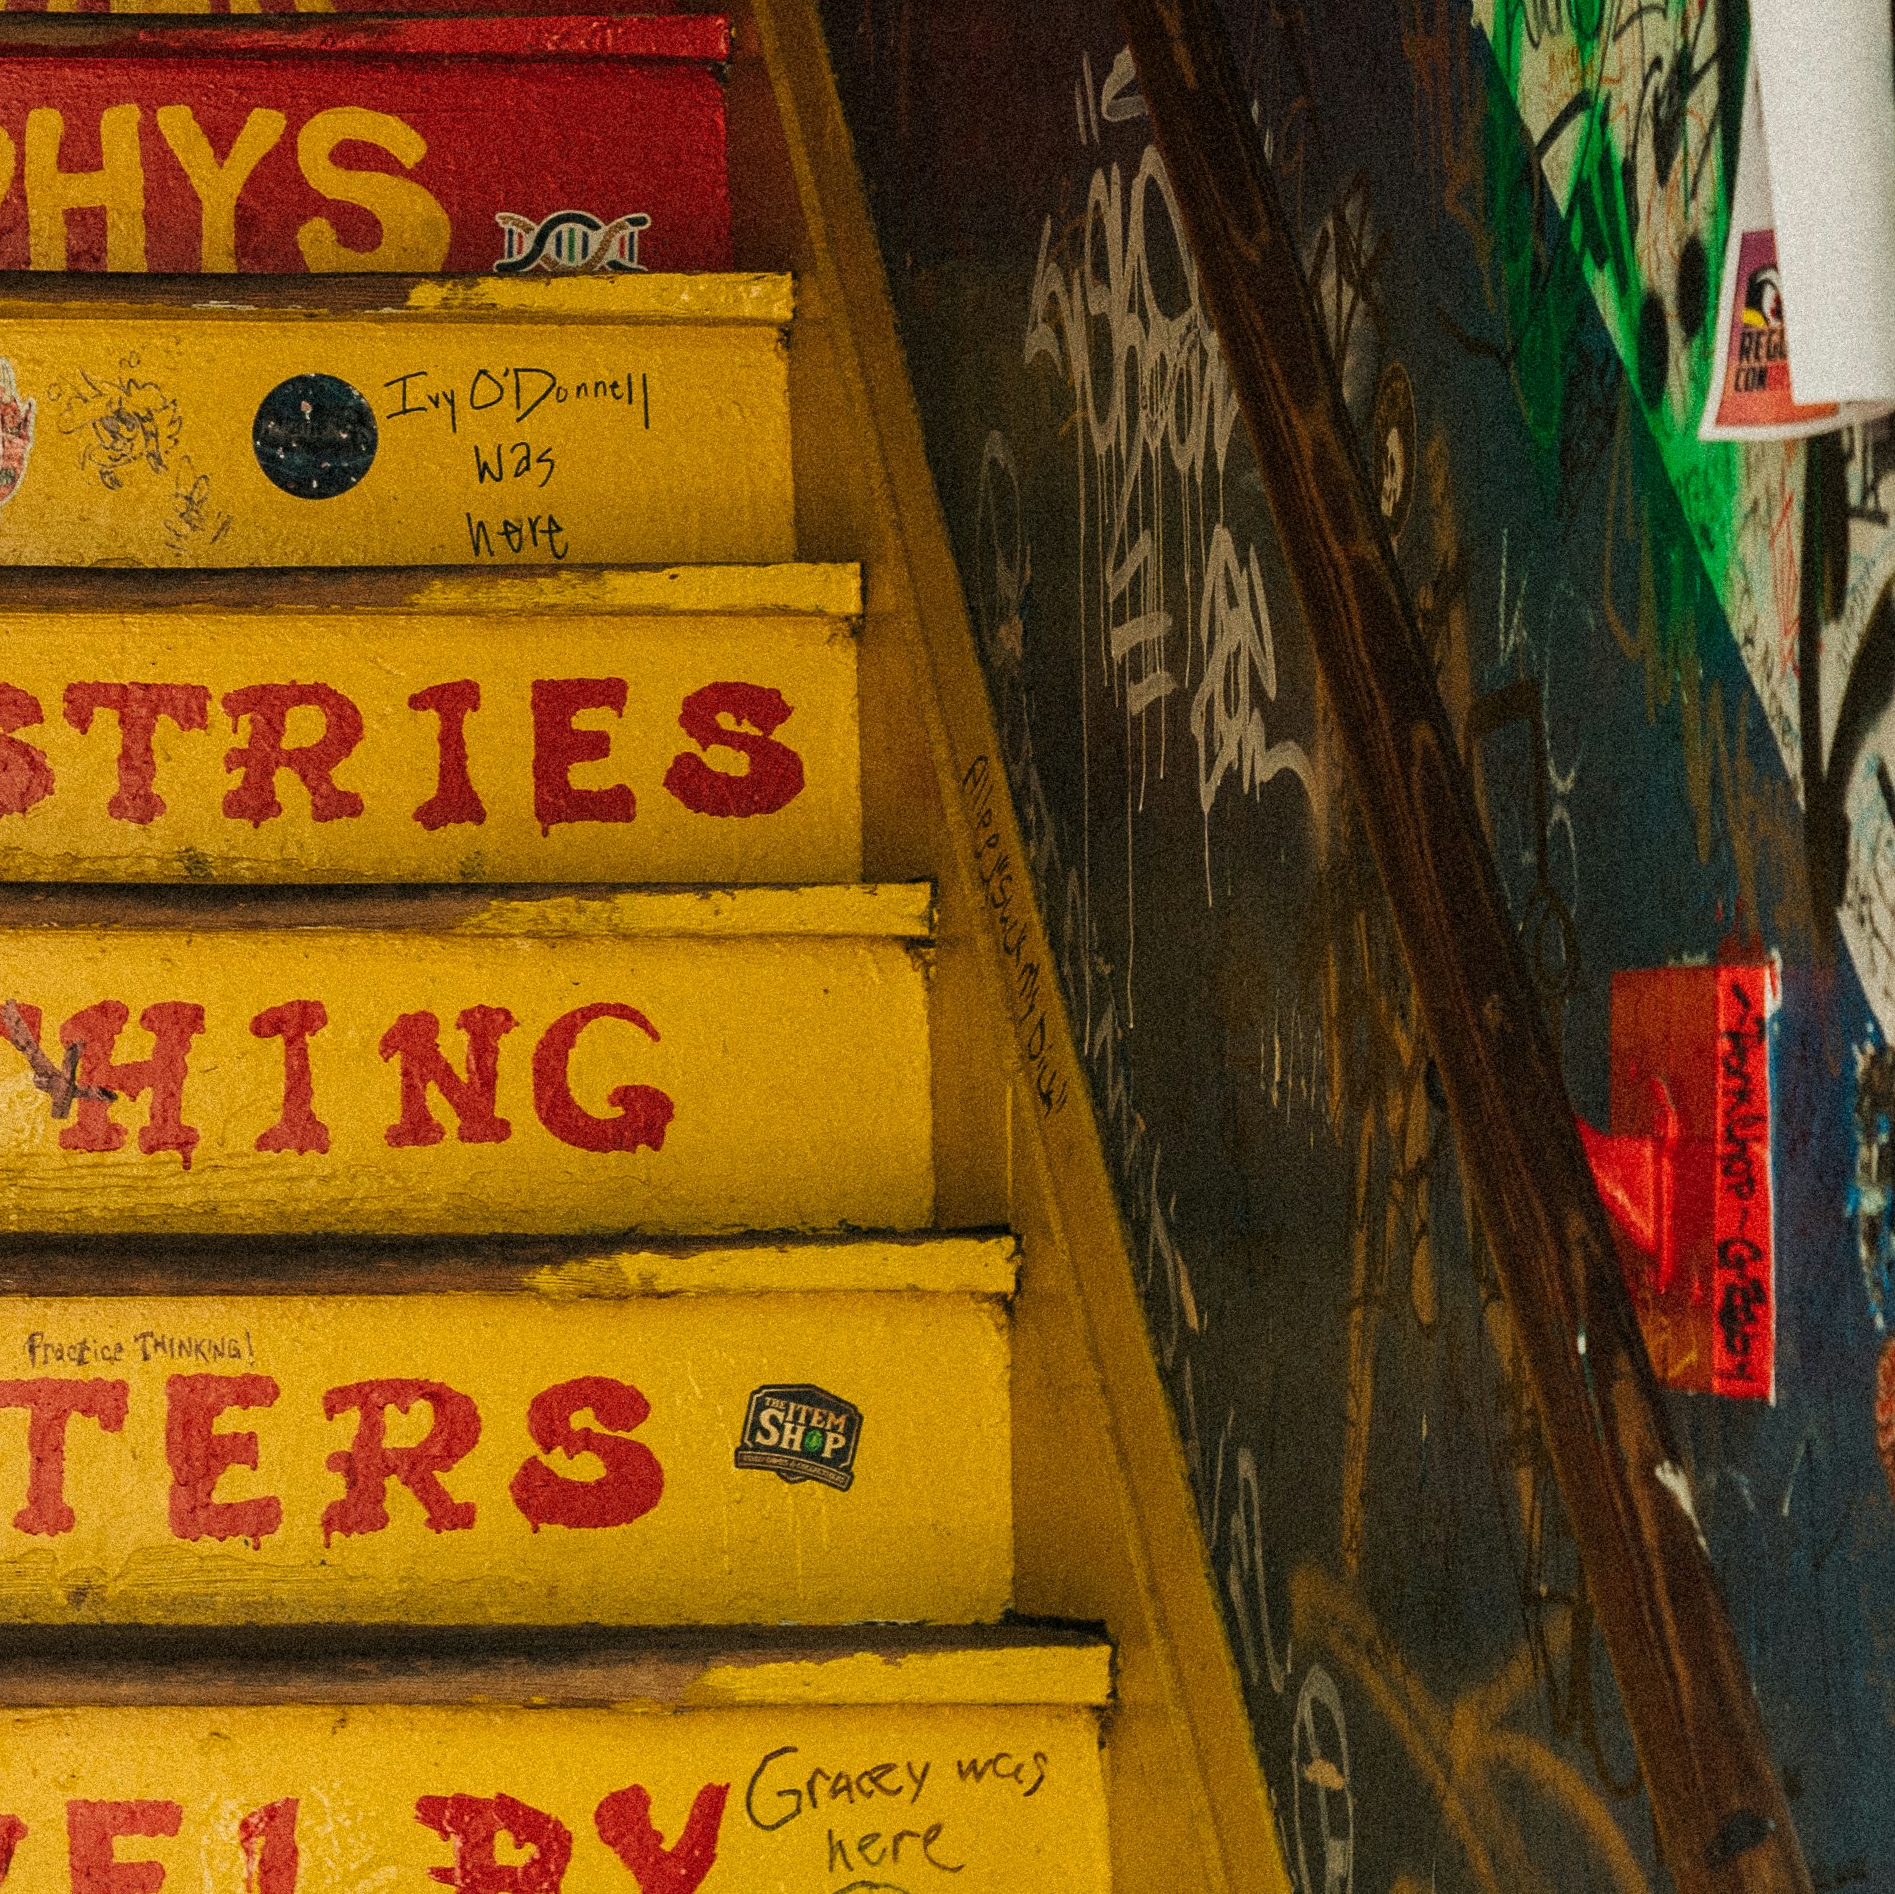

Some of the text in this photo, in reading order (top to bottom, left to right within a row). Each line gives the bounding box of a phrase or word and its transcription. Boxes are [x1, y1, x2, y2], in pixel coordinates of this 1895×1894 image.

[383, 371, 458, 433] Ivy
[474, 440, 555, 488] was
[465, 510, 570, 561] here
[25, 1328, 256, 1368] Practice THINKING!
[755, 1407, 847, 1459] SHOP
[785, 1401, 850, 1433] ITEM
[957, 1751, 1048, 1797] was
[827, 1821, 966, 1873] here
